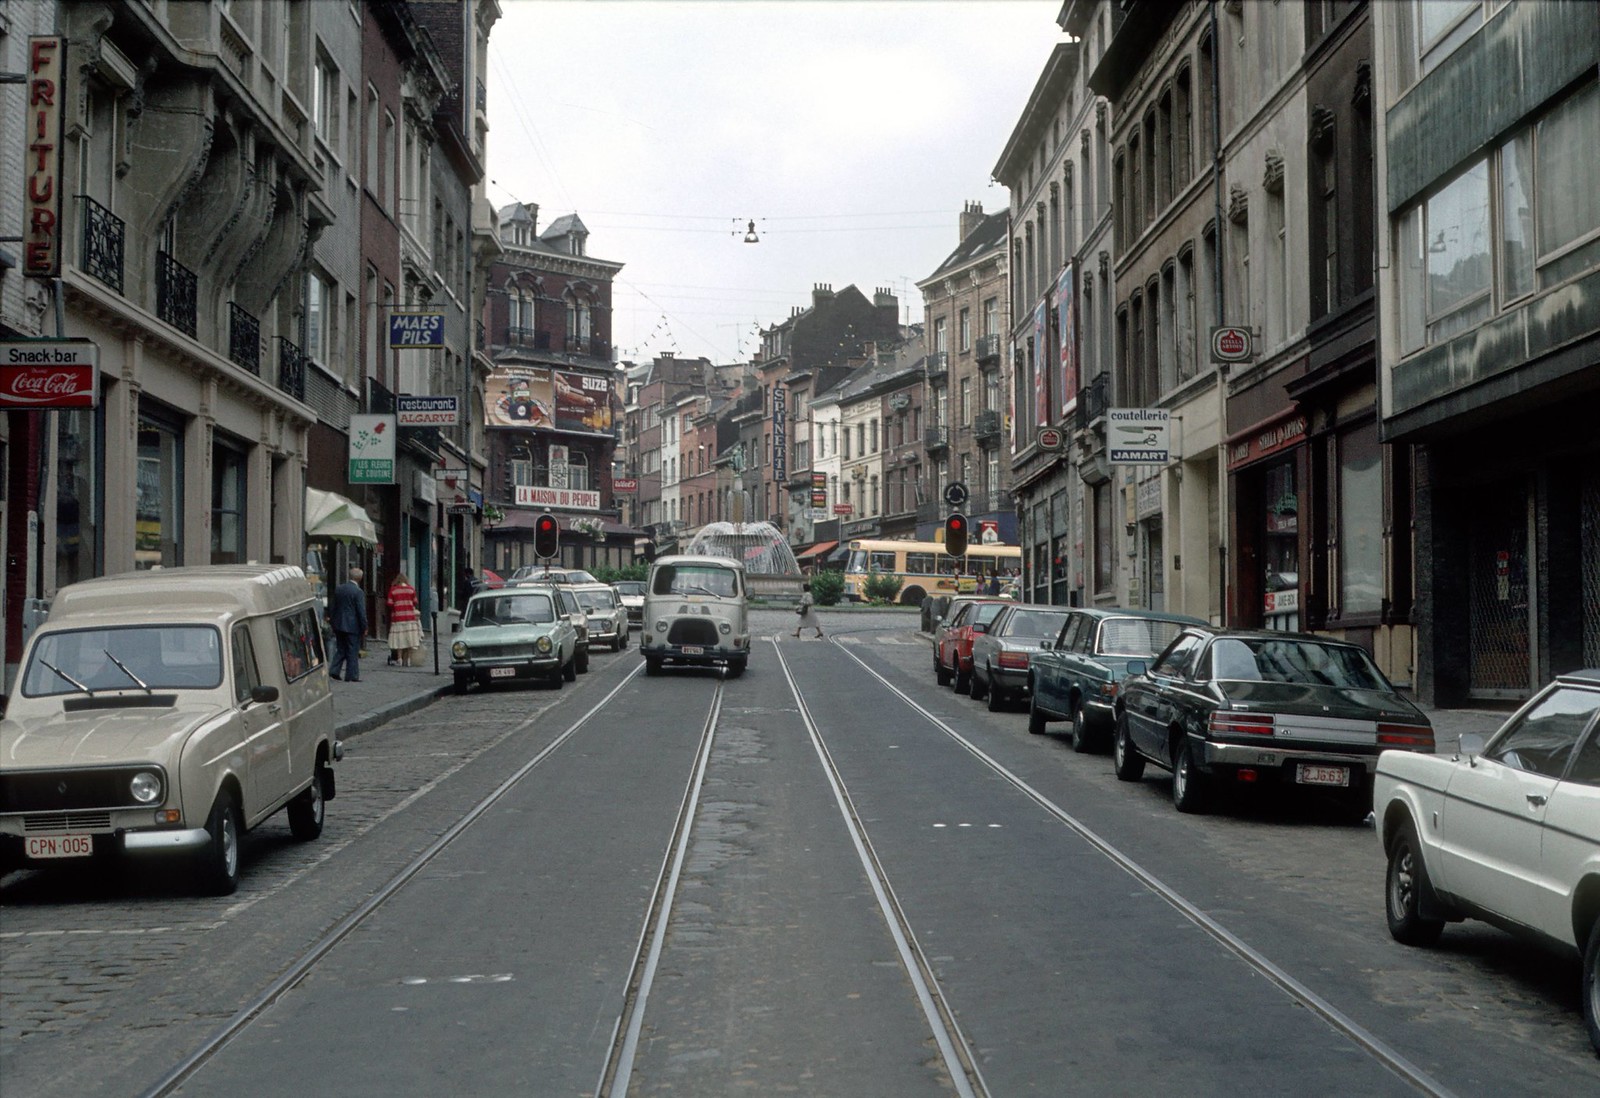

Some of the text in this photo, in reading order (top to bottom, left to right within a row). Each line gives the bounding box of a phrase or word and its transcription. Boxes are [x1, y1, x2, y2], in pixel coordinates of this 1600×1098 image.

[26, 40, 57, 272] FRITURE
[393, 315, 439, 330] MAES
[401, 330, 431, 345] PILS
[11, 372, 79, 394] Coca-Cola
[400, 398, 455, 410] restaurant
[400, 413, 456, 424] ALGARVE
[1110, 409, 1168, 421] coutellerie
[773, 389, 785, 481] SPINETTE
[1113, 451, 1167, 460] JAMART
[358, 460, 369, 469] LES
[355, 469, 364, 478] DE
[518, 489, 598, 508] LA MAISON DU PEUPLE
